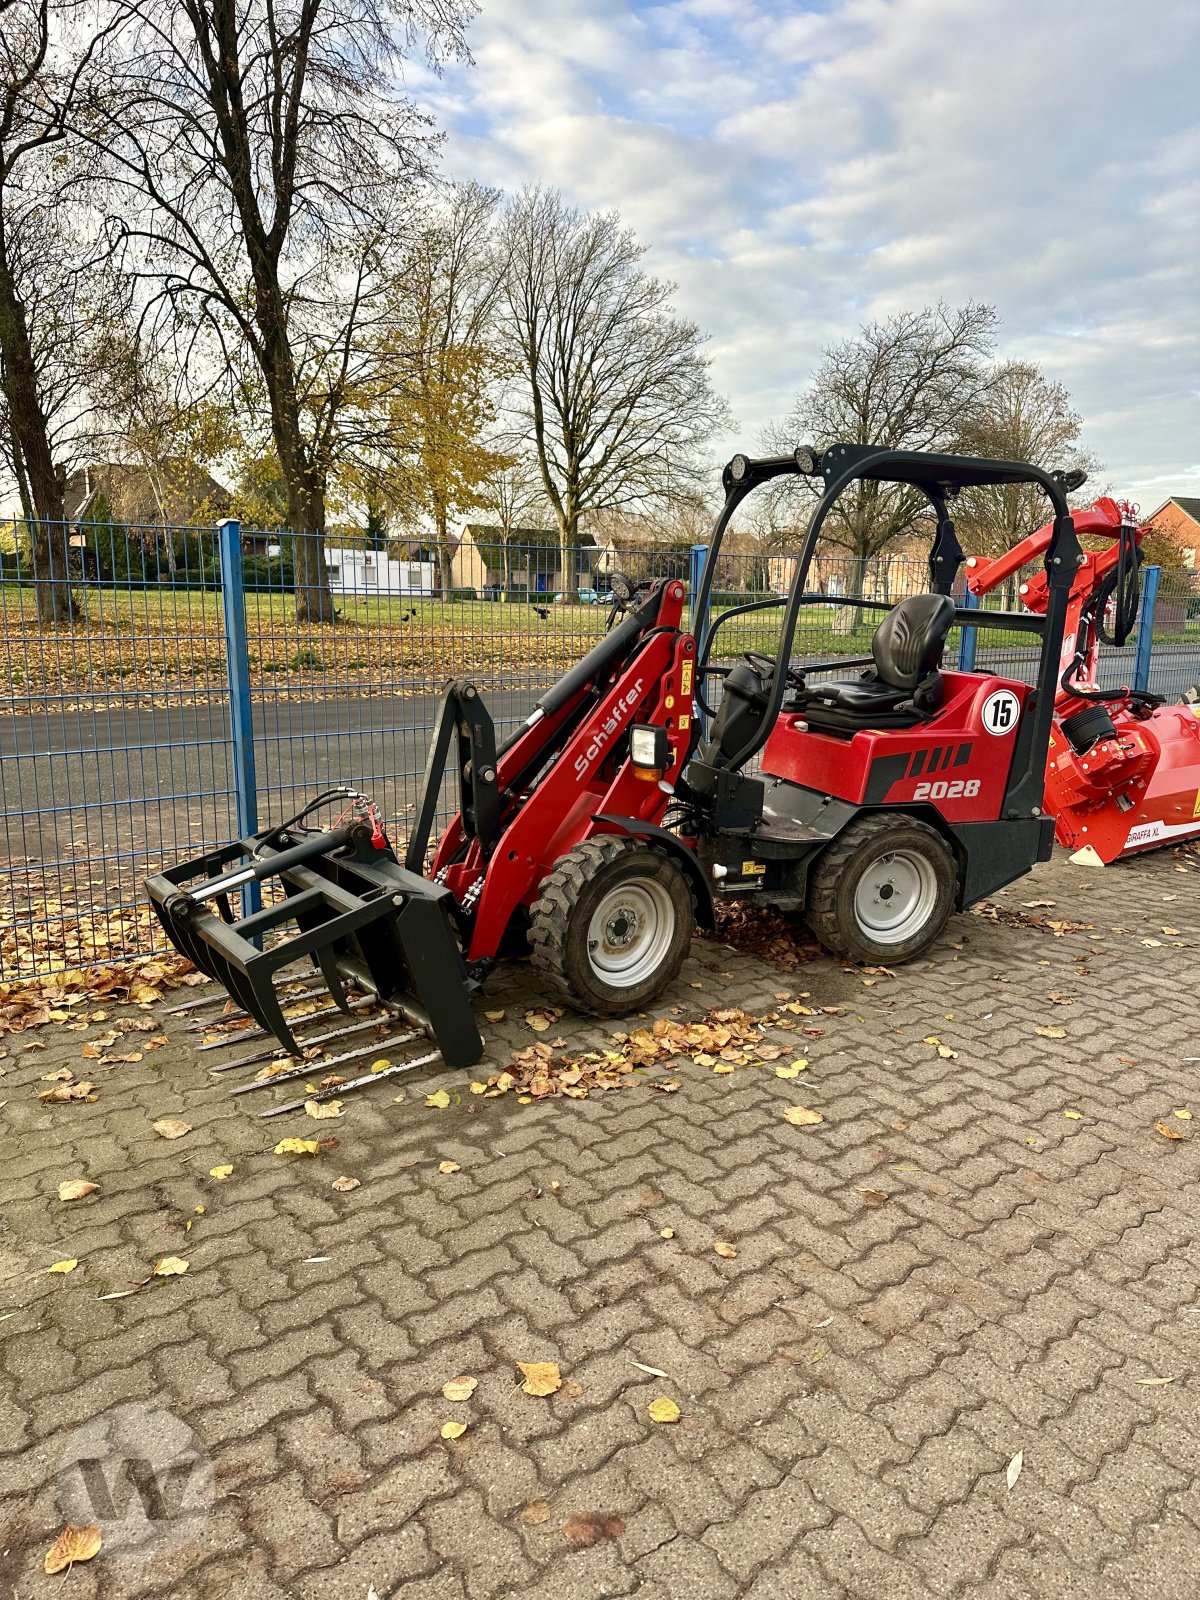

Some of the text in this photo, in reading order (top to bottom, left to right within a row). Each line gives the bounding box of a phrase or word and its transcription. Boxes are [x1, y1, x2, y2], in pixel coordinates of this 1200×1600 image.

[992, 700, 1013, 728] 15
[575, 678, 643, 782] Schäffer
[912, 779, 981, 801] 2028
